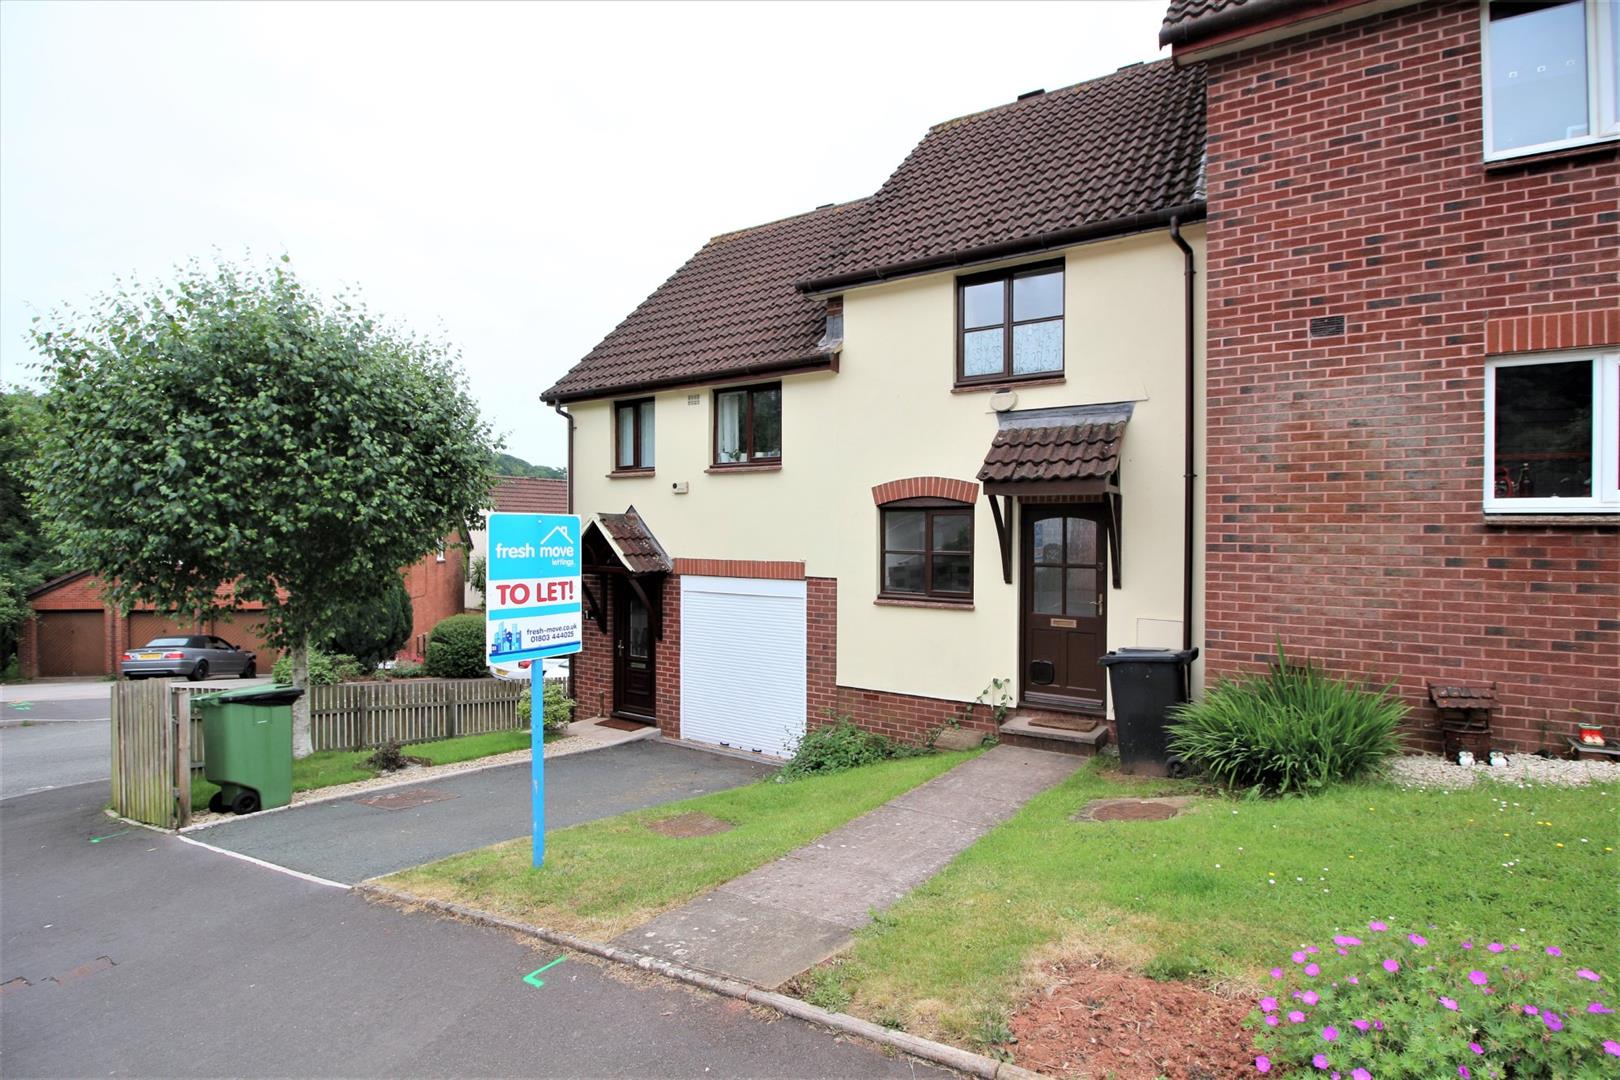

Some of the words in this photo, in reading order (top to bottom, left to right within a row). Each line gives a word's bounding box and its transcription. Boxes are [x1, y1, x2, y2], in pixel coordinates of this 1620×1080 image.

[495, 543, 536, 559] fresh
[540, 546, 574, 558] move
[496, 583, 530, 605] TO
[537, 580, 573, 602] LET!
[526, 624, 577, 635] fresh-move.co.uk
[530, 634, 550, 643] 01803
[551, 630, 574, 640] 444025
